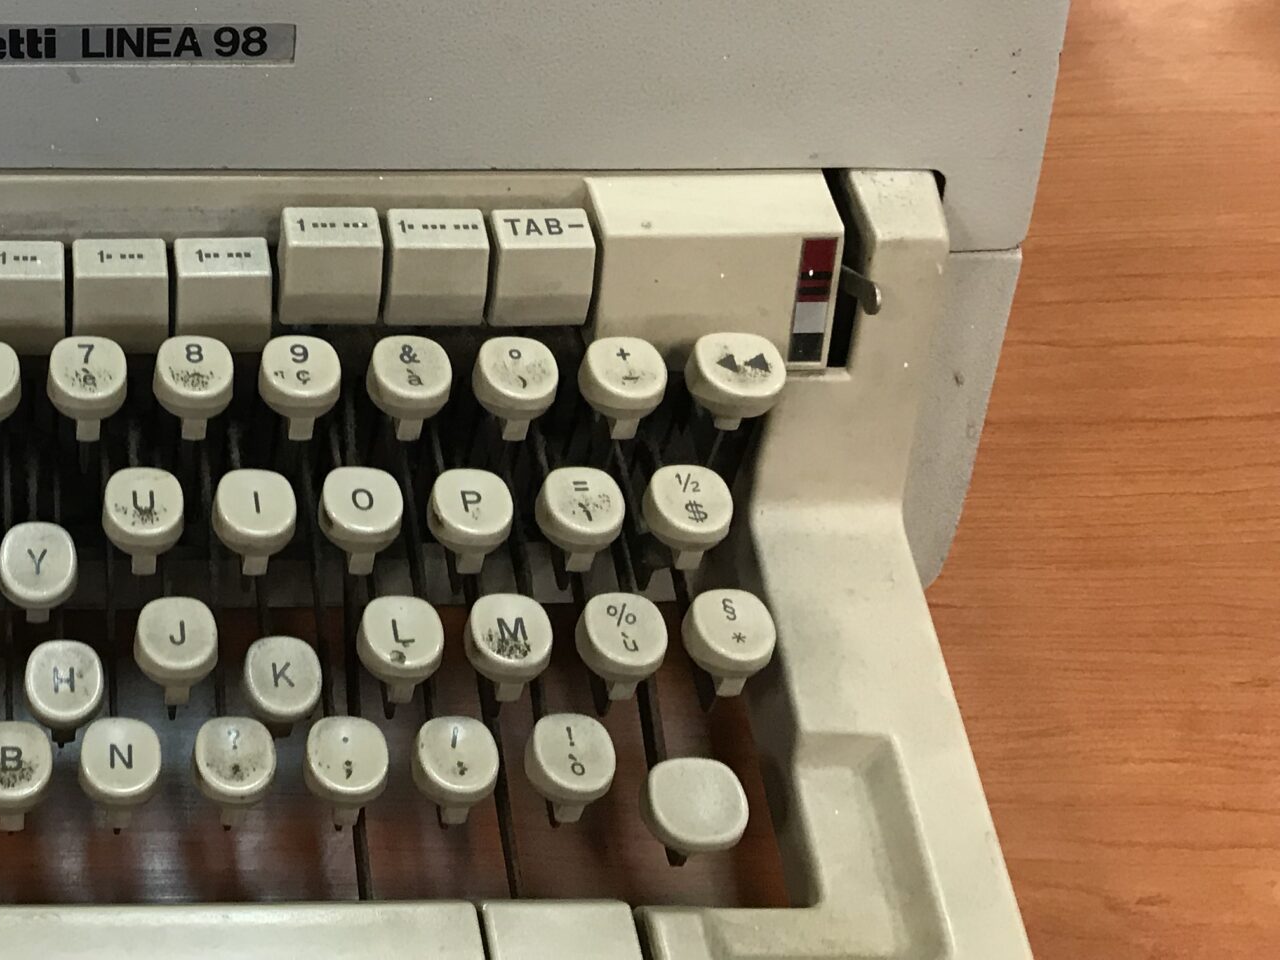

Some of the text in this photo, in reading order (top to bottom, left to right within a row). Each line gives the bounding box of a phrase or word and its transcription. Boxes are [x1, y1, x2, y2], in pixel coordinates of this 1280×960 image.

[81, 26, 203, 58] LINEA
[213, 25, 269, 57] 98
[77, 343, 95, 364] 7
[185, 343, 204, 363] 8
[289, 343, 309, 363] 9
[399, 343, 421, 364] &
[131, 489, 155, 512] U
[253, 490, 261, 514] I
[351, 487, 375, 511] O
[460, 490, 483, 512] P
[684, 499, 709, 524] $
[27, 548, 48, 575] Y
[606, 602, 637, 628] %
[169, 619, 186, 645] J
[391, 618, 416, 644] L
[496, 616, 529, 642] M
[52, 665, 76, 694] H
[271, 661, 296, 688] K
[0, 745, 24, 772] B
[108, 743, 134, 770] N
